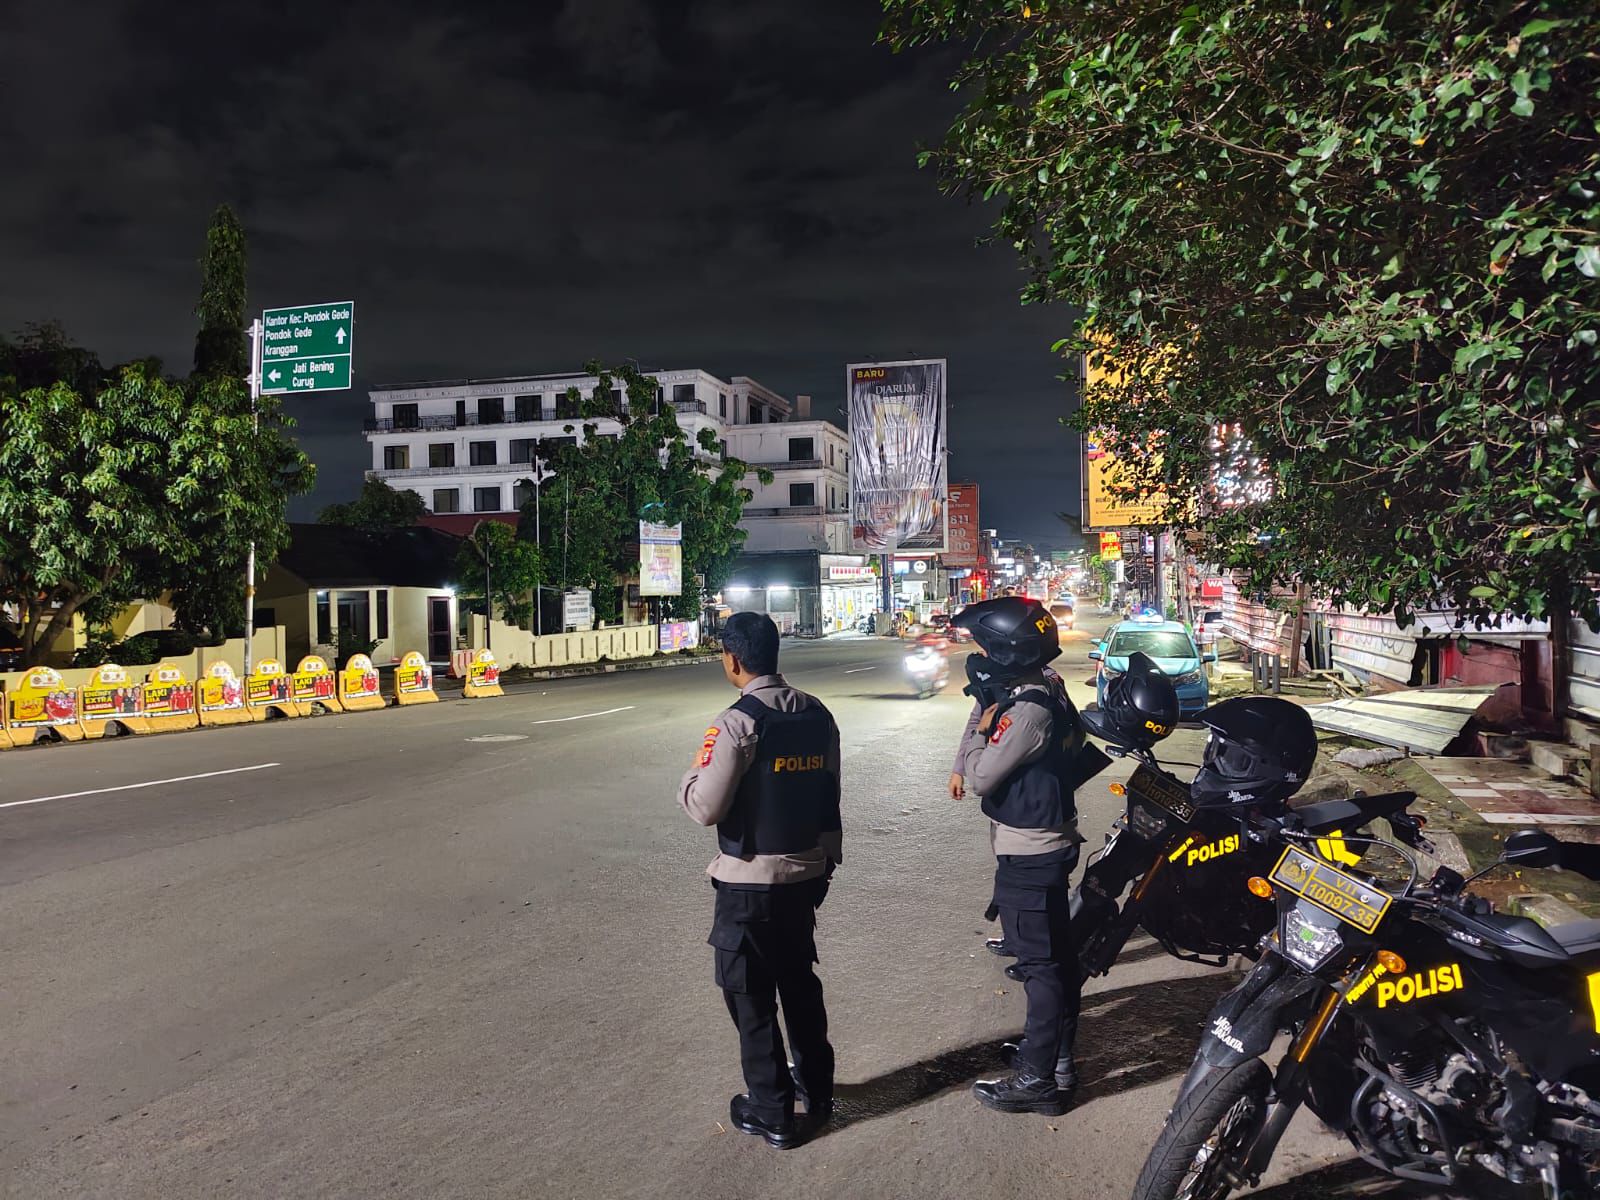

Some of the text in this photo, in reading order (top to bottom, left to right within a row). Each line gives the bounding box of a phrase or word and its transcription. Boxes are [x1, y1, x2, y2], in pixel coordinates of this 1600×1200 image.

[266, 316, 288, 327] Kantor
[332, 309, 350, 320] Gede
[265, 327, 312, 341] Pondok Gede
[265, 345, 298, 357] Kranggan
[292, 361, 334, 374] Jati Bening
[857, 370, 884, 378] BARU
[292, 377, 314, 388] Curug
[875, 384, 916, 395] DJARUM
[294, 677, 312, 686] LAKI
[146, 688, 167, 698] LAKI
[85, 696, 112, 704] EXTRA
[774, 755, 824, 773] POLISI
[1187, 834, 1239, 866] POLISI
[1336, 877, 1358, 895] VII
[1309, 883, 1375, 928] 10097-35
[1378, 963, 1463, 1008] POLISI
